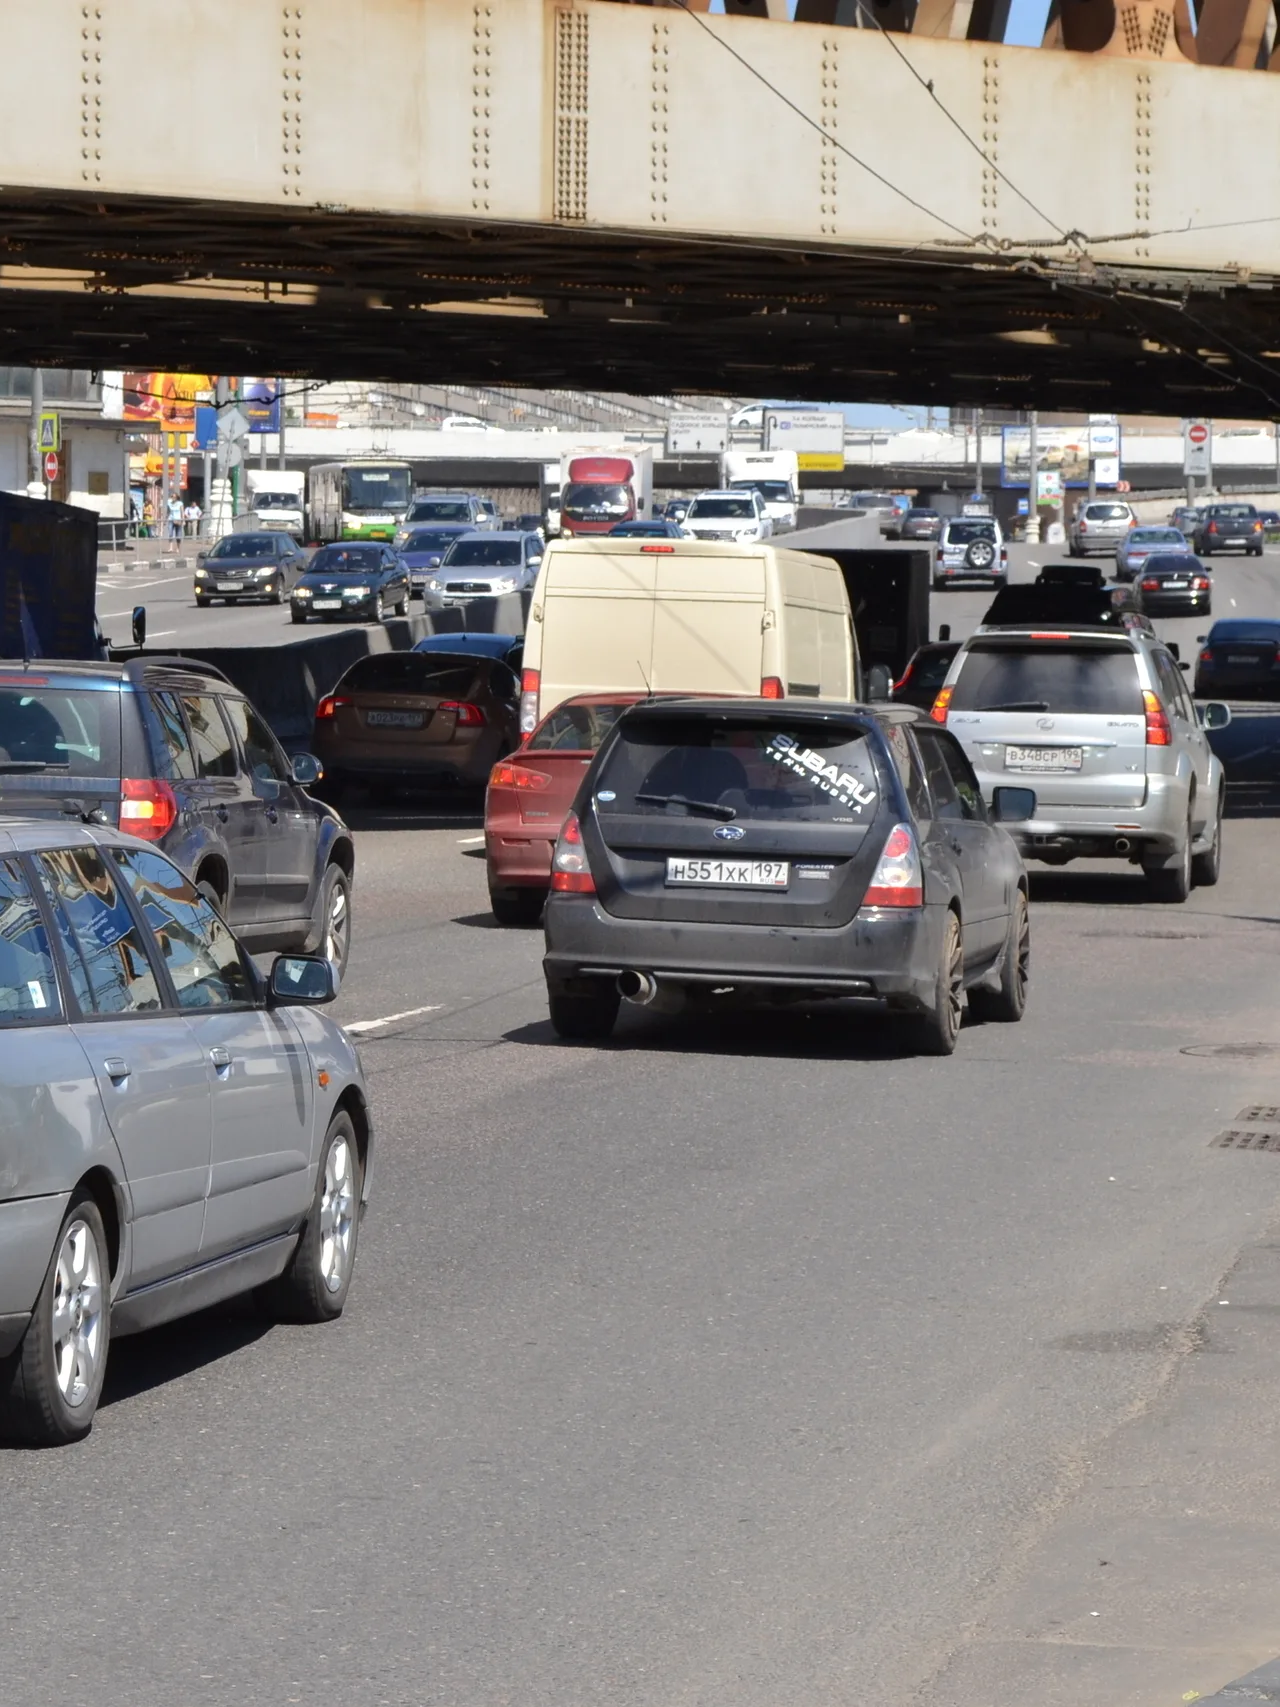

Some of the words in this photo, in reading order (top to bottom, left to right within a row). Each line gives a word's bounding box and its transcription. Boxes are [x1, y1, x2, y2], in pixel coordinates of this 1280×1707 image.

[772, 733, 877, 805] SUBARU
[810, 775, 862, 815] RUSSIA
[755, 863, 782, 878] 197
